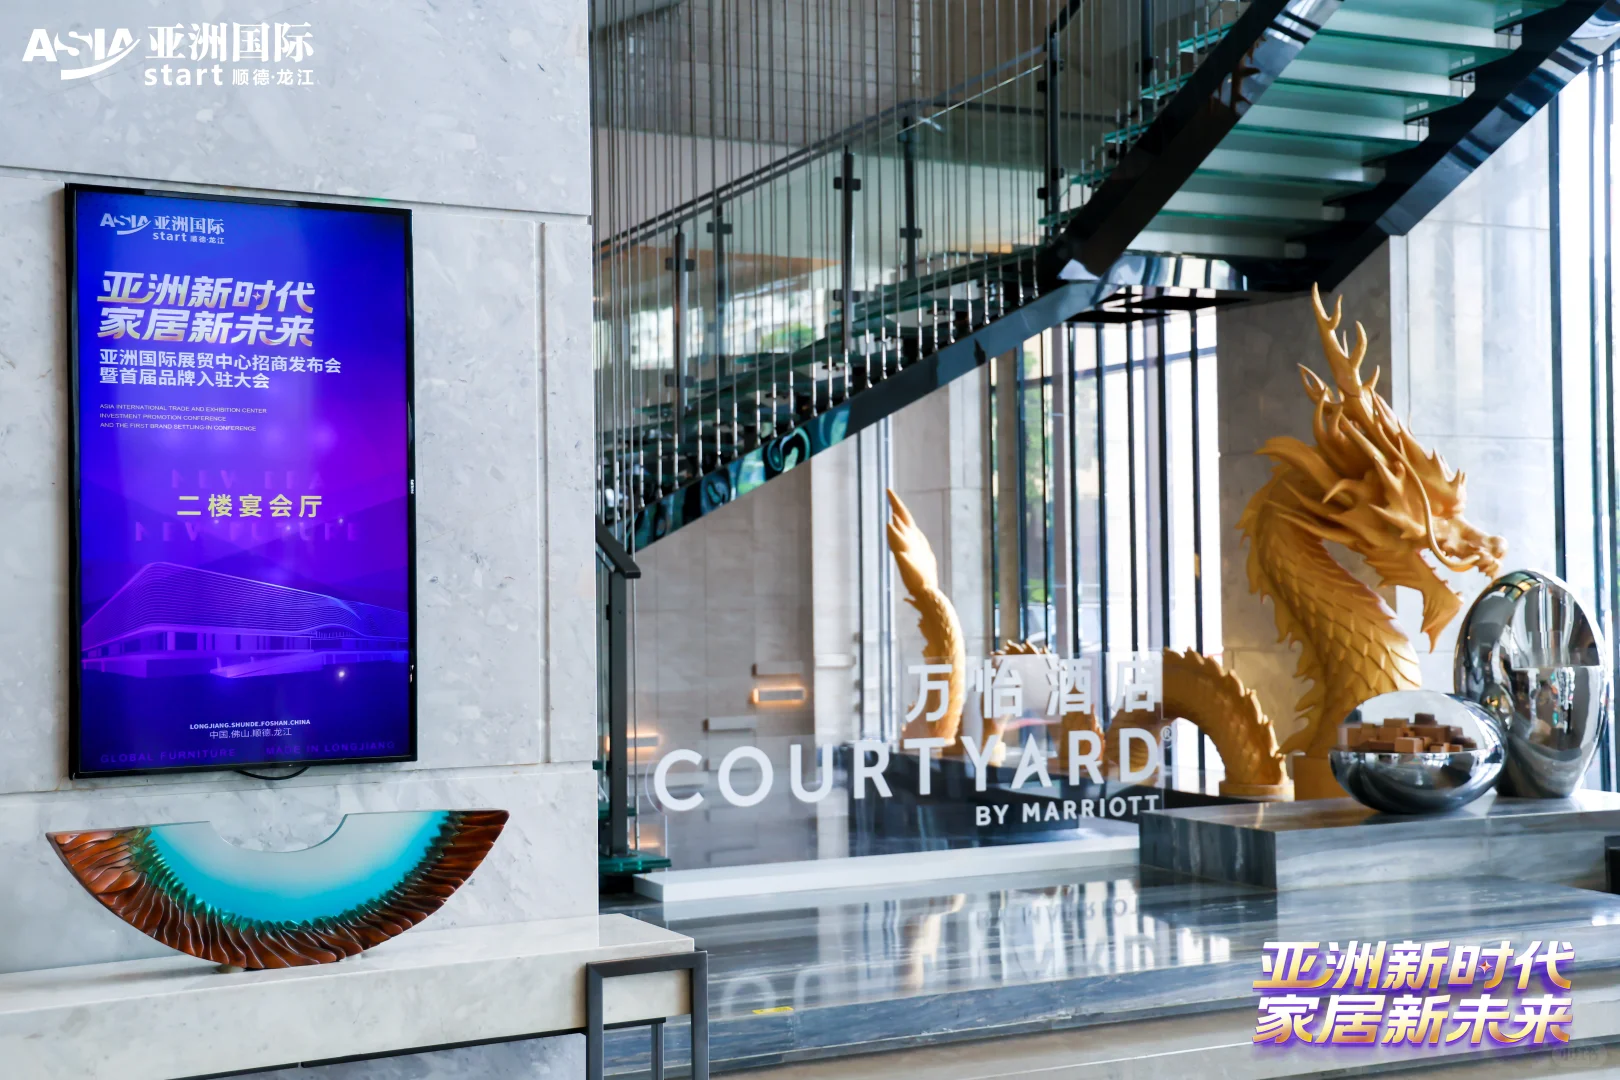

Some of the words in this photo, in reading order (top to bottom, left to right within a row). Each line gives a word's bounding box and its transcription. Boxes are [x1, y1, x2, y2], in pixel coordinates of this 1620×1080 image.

[99, 213, 152, 234] ASIA
[153, 215, 225, 235] 亚洲国际
[152, 232, 188, 243] start
[97, 270, 316, 314] 亚洲新时代
[97, 306, 315, 347] 家居新未来
[99, 348, 342, 374] 亚洲国际展贸中心招商发布会
[99, 366, 270, 390] 暨首届品牌入驻大会
[99, 412, 142, 420] INVESTMENT
[142, 413, 182, 421] PROMOTION
[176, 493, 323, 519] 二楼宴会厅
[905, 652, 1161, 724] 万怡酒店
[100, 750, 155, 763] GLOBAL
[159, 748, 237, 761] FURNITURE
[265, 744, 301, 756] MADE
[305, 742, 319, 754] IN
[323, 740, 396, 753] LONGJIANG
[975, 804, 1010, 827] BY
[1021, 793, 1161, 825] MARRIOTT
